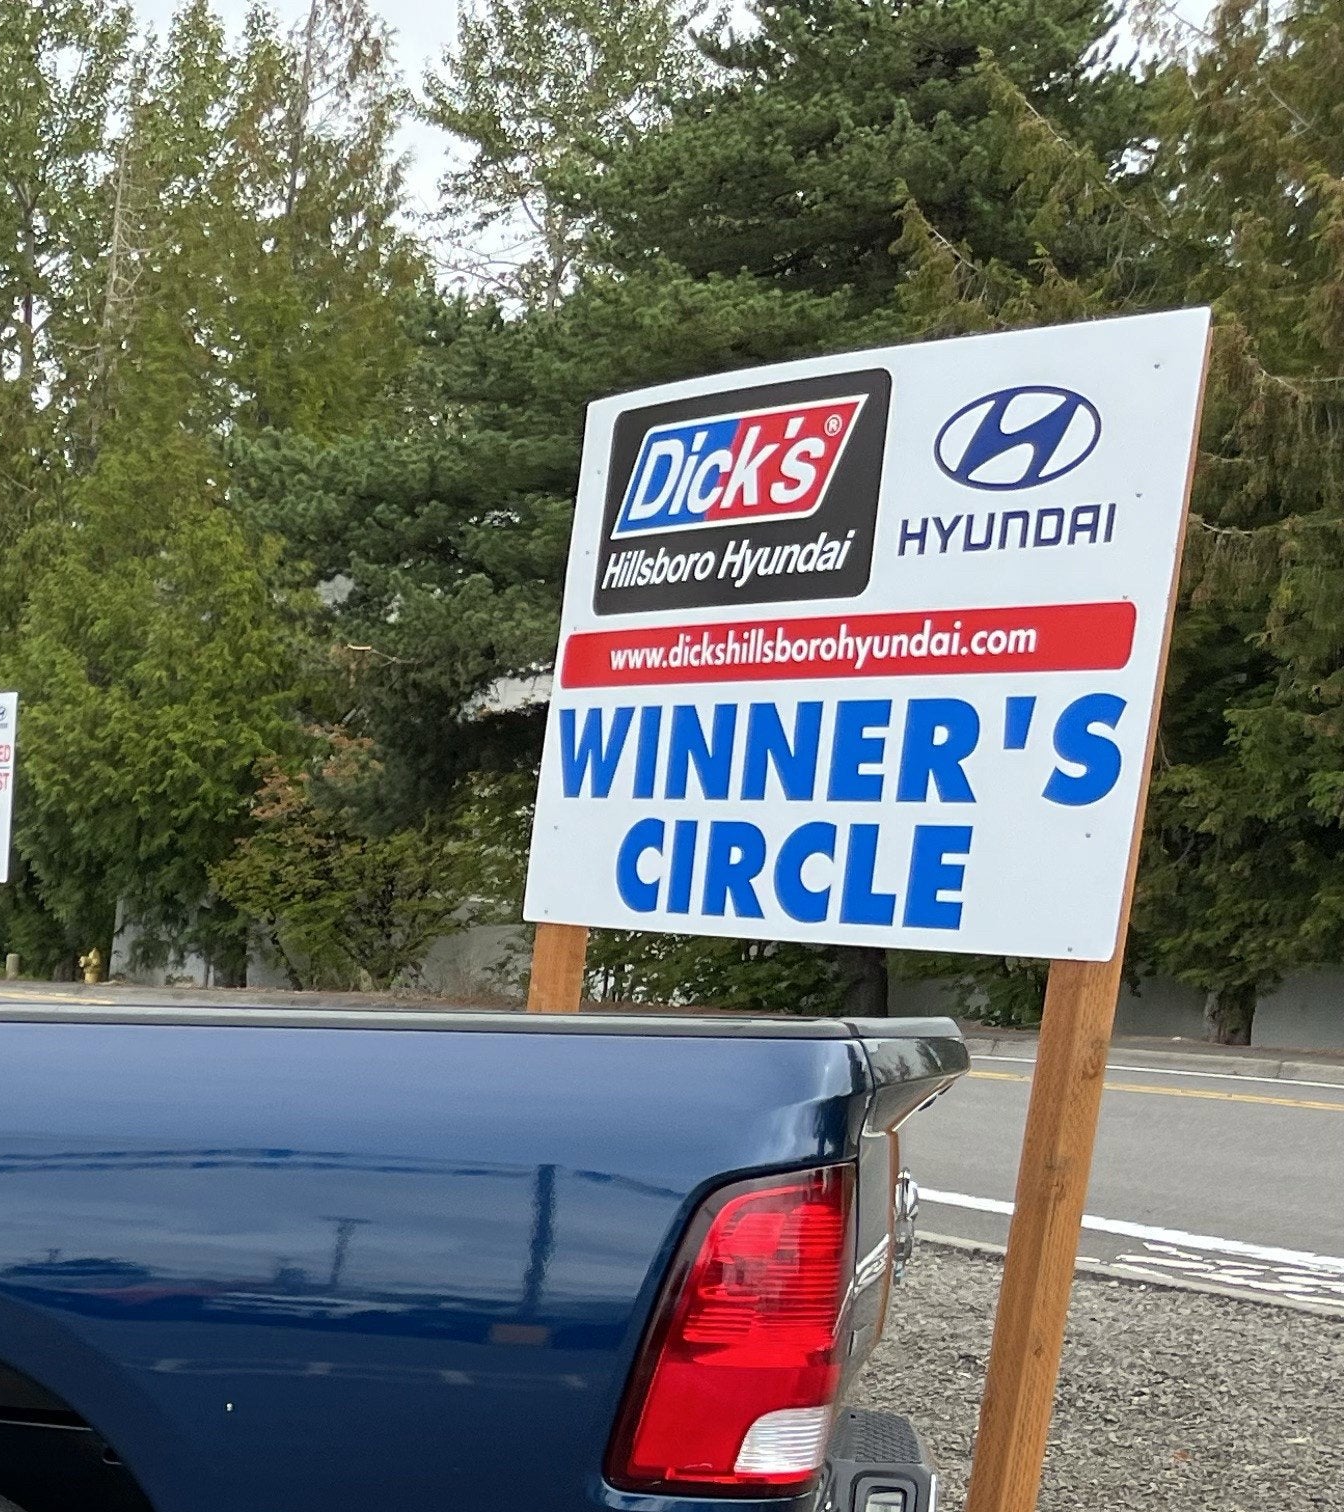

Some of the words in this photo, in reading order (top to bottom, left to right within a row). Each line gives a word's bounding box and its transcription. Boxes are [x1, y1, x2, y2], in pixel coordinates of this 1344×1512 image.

[628, 417, 826, 521] Dick's
[602, 548, 713, 590] Hillsboro
[717, 529, 856, 588] Hyundai
[898, 502, 1116, 557] HYUNDAI
[610, 618, 1037, 672] www.dickshillsborohyundai.com
[558, 692, 1129, 808] WINNER'S
[615, 818, 974, 932] CIRCLE
